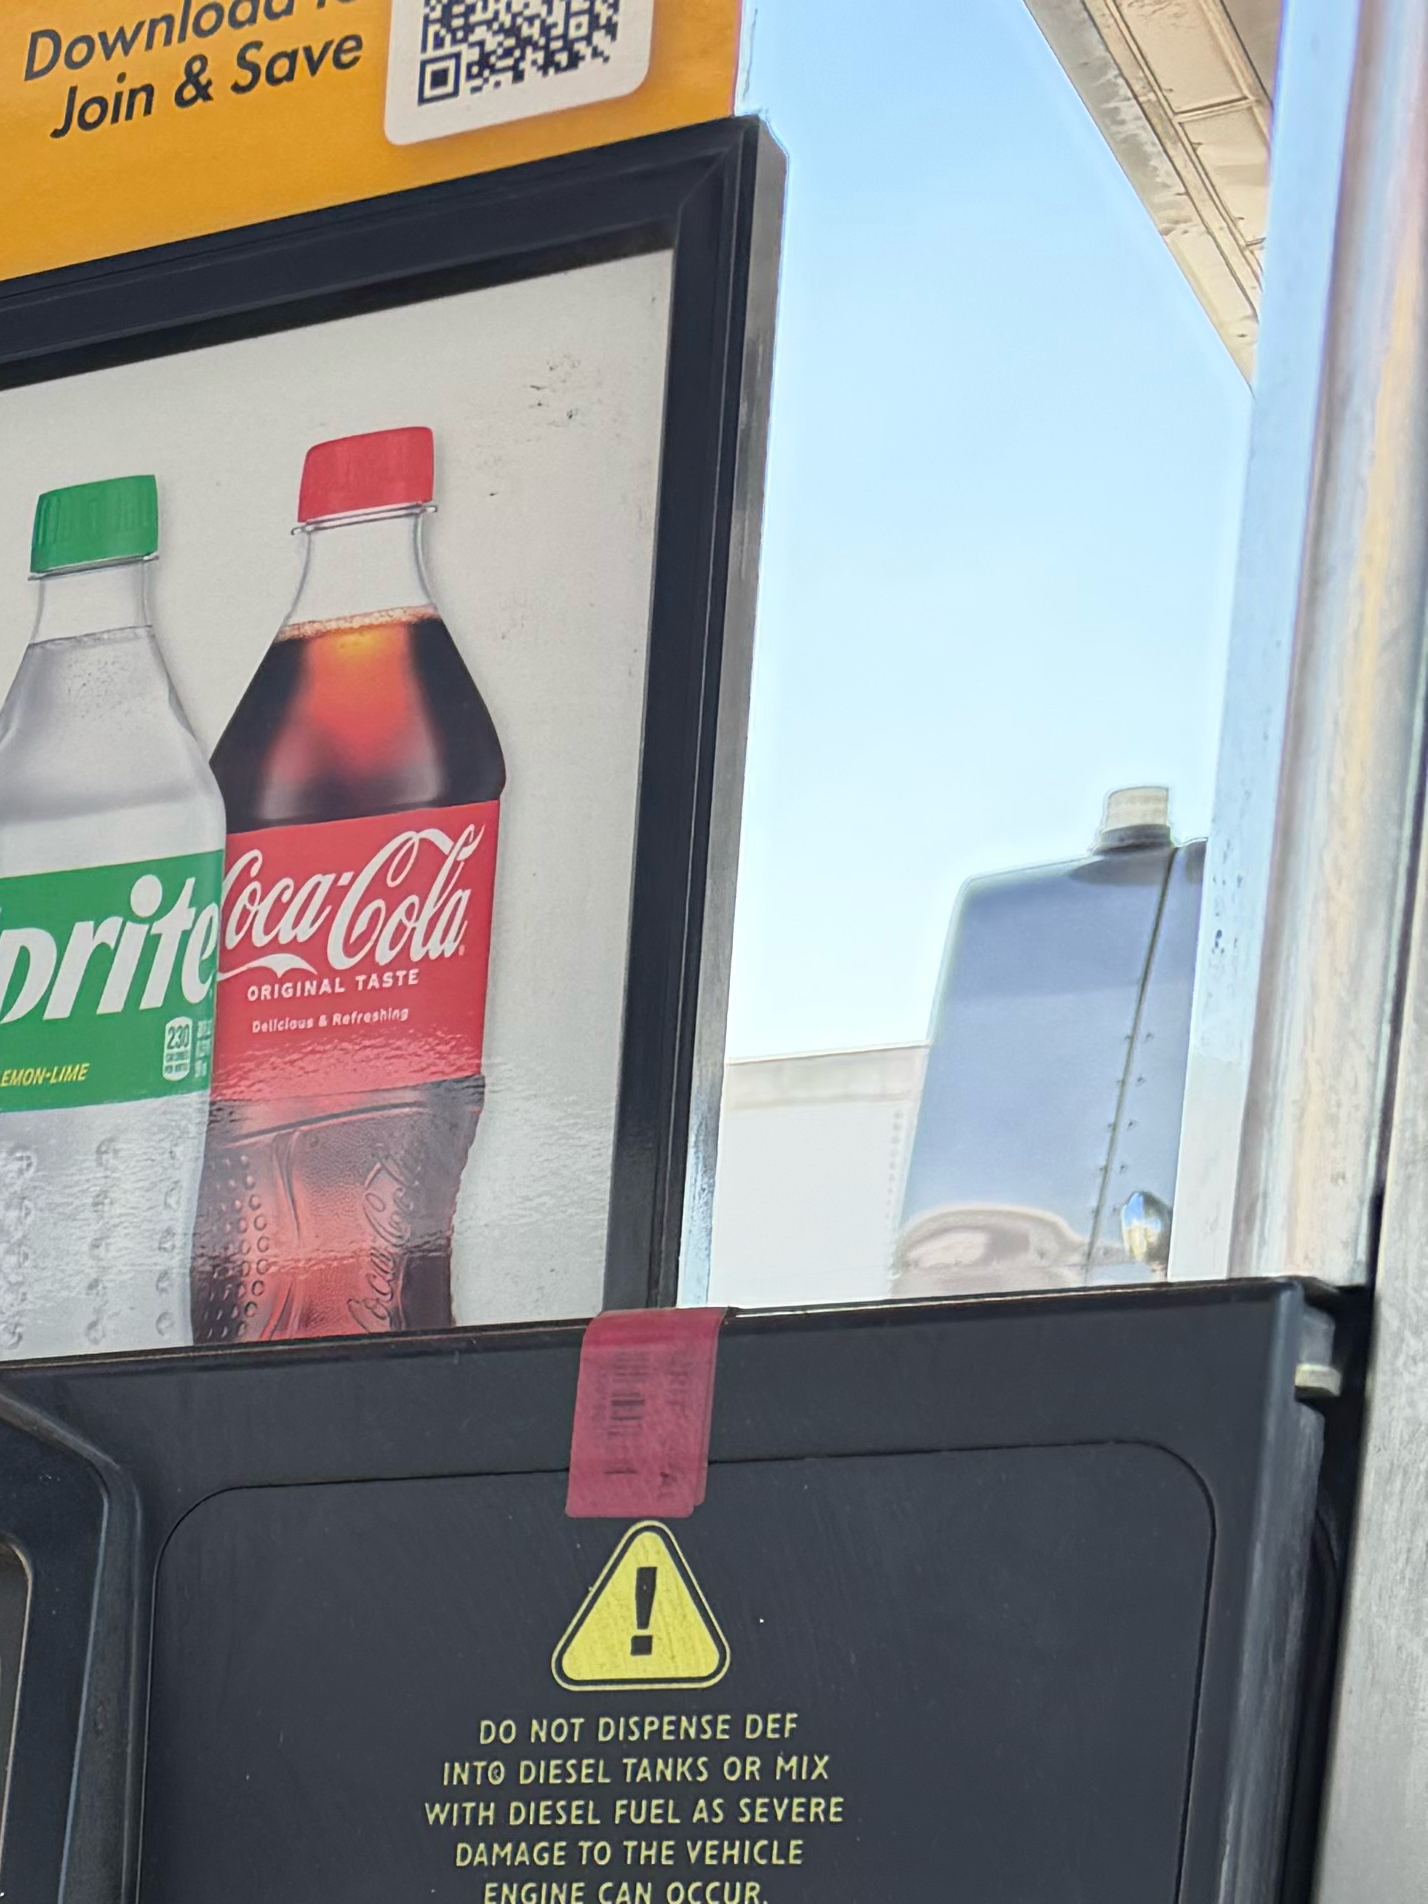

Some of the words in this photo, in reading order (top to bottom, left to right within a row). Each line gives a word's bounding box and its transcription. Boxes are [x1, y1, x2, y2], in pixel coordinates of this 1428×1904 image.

[49, 72, 155, 138] Join
[173, 54, 214, 109] &
[230, 33, 364, 94] Save
[220, 824, 486, 970] Coca-Cola
[247, 978, 346, 1002] ORIGINAL
[355, 968, 420, 992] TASTE
[252, 1016, 314, 1033] Delicious
[318, 1015, 328, 1028] &
[332, 1008, 409, 1026] Refreshing
[479, 1719, 517, 1745] DO
[530, 1717, 585, 1743] NOT
[597, 1714, 732, 1743] DISPENSE
[744, 1713, 799, 1739] DEF
[443, 1760, 506, 1786] INTO
[519, 1757, 612, 1785] DIESEL
[622, 1756, 709, 1784] TANKS
[722, 1755, 761, 1782] OR
[774, 1754, 831, 1782] MIX
[424, 1801, 495, 1827] WITH
[508, 1800, 601, 1826] DIESEL
[615, 1798, 681, 1825] FUEL
[692, 1798, 725, 1824] AS
[738, 1796, 845, 1824] SEVERE
[455, 1841, 567, 1868] DAMAGE
[577, 1840, 611, 1866] TO
[623, 1840, 675, 1866] THE
[686, 1839, 804, 1865] VEHICLE
